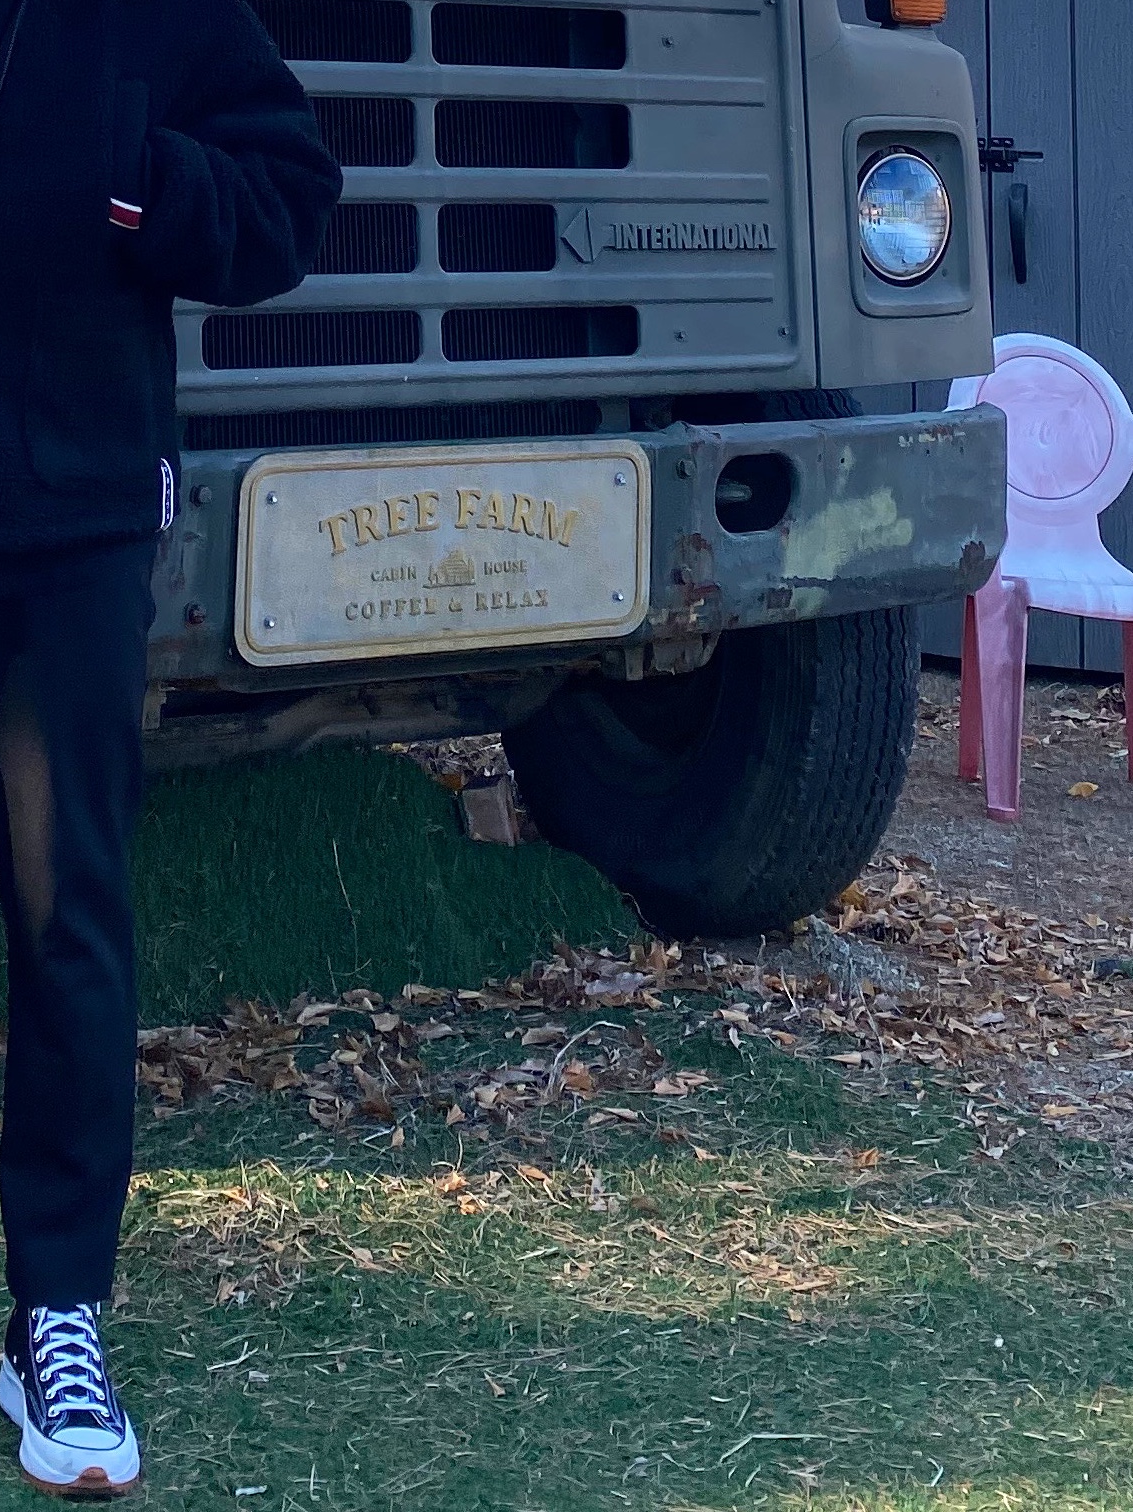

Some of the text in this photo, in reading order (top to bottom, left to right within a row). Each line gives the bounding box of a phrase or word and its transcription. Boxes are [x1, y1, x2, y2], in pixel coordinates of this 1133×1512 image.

[613, 222, 777, 250] INTERNATIONAL
[319, 489, 579, 556] TREE FARM
[370, 559, 528, 583] CABIN HOUSE
[345, 588, 549, 621] COFFEE & RELAX
